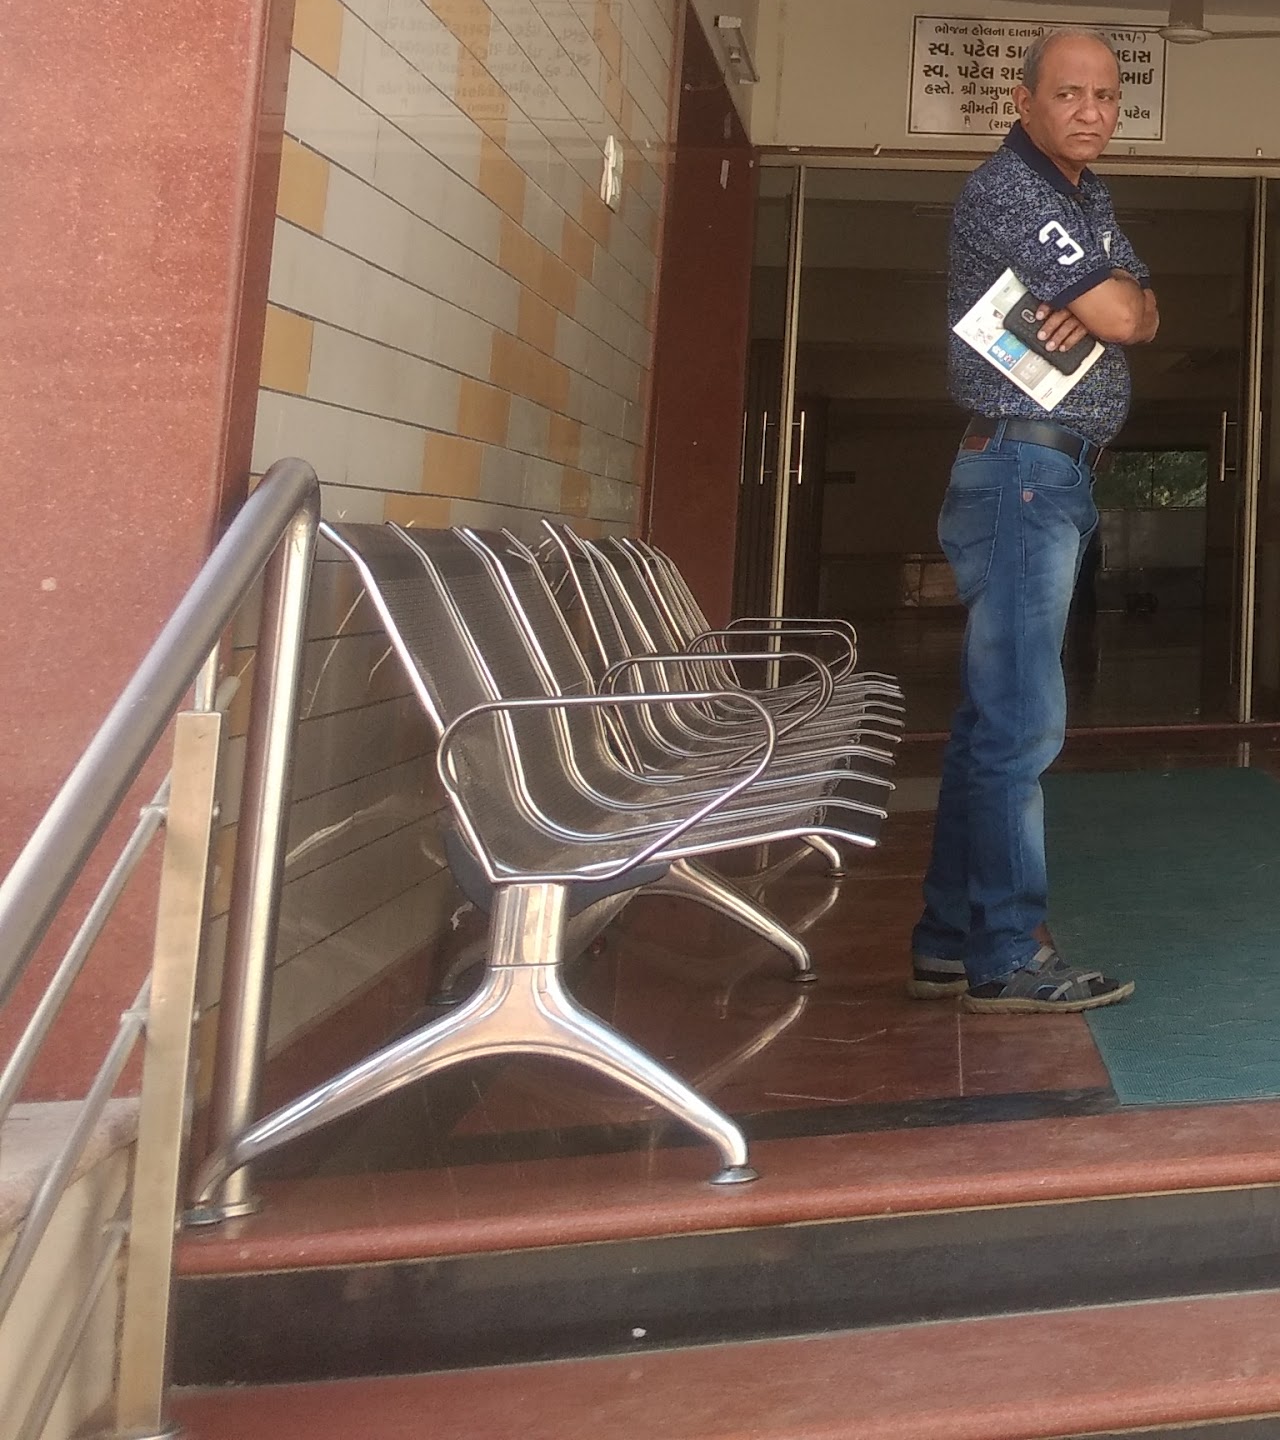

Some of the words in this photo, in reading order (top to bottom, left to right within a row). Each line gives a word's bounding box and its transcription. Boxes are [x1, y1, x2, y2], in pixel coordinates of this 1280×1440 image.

[935, 23, 968, 35] ભોજન
[971, 24, 1005, 37] હોલના
[1008, 26, 1044, 37] દાતાશ્રી
[928, 42, 955, 56] સ્વ.
[963, 39, 1000, 58] પટેલ
[922, 64, 949, 78] સ્વ.
[957, 61, 994, 80] પટેલ
[960, 82, 976, 95] શ્રી
[959, 101, 998, 115] શ્રીમતી
[1124, 105, 1150, 119] પટેલ
[1039, 220, 1085, 266] 3
